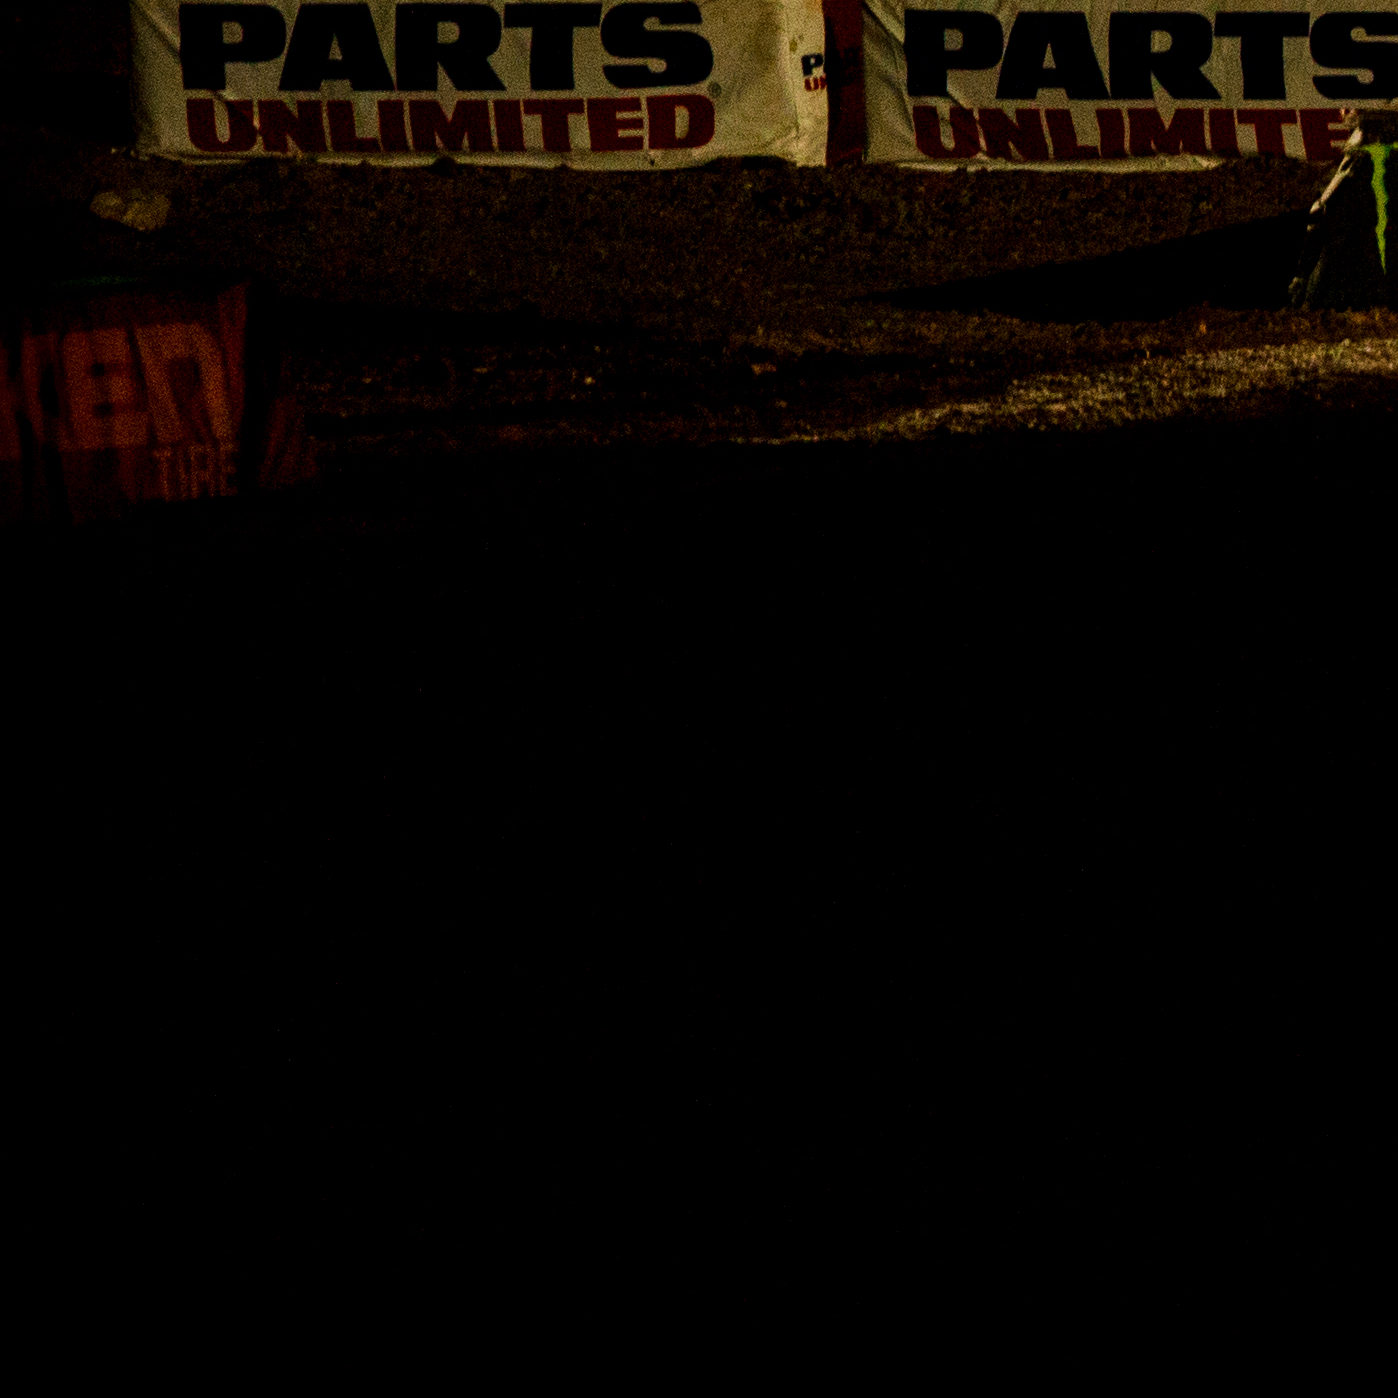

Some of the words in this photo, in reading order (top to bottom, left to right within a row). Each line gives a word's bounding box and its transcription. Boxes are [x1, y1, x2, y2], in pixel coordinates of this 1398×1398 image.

[178, 2, 714, 91] PARTS
[186, 95, 715, 153] UNLIMITED
[912, 105, 1366, 160] UNLIMITE
